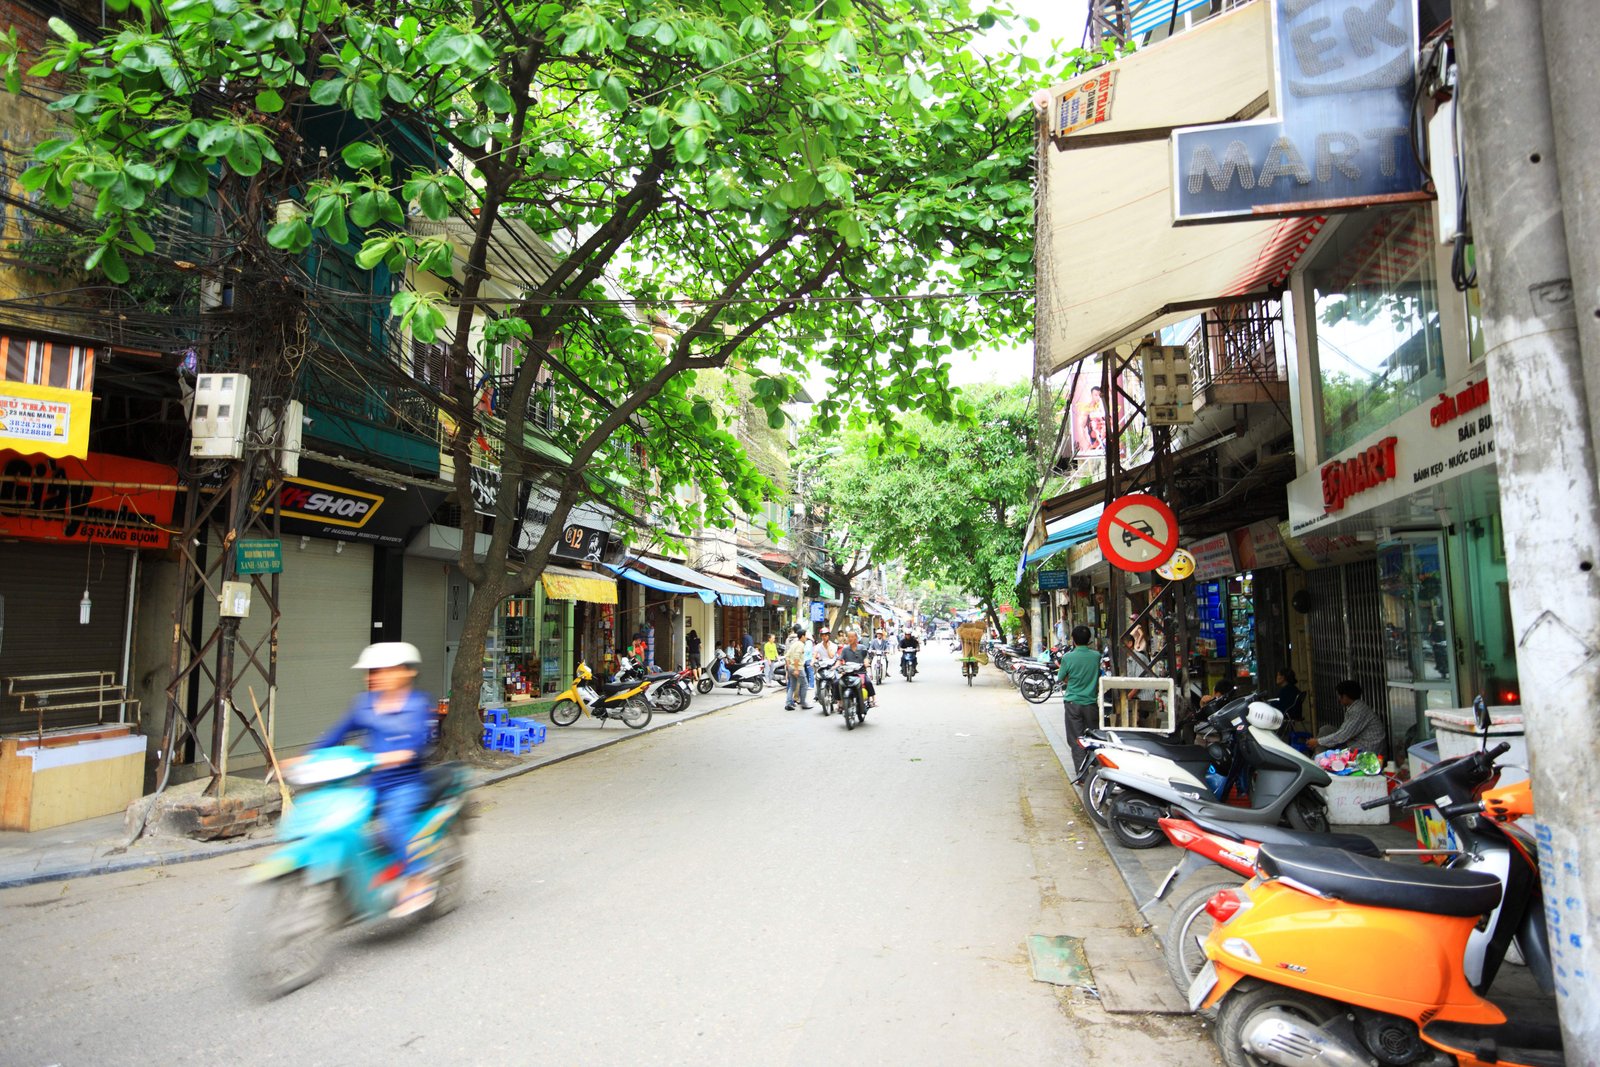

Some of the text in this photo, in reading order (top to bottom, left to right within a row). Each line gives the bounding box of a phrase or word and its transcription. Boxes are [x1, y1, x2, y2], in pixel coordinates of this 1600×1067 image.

[1289, 0, 1408, 78] EK
[1188, 126, 1409, 194] MART
[1478, 414, 1493, 433] BU
